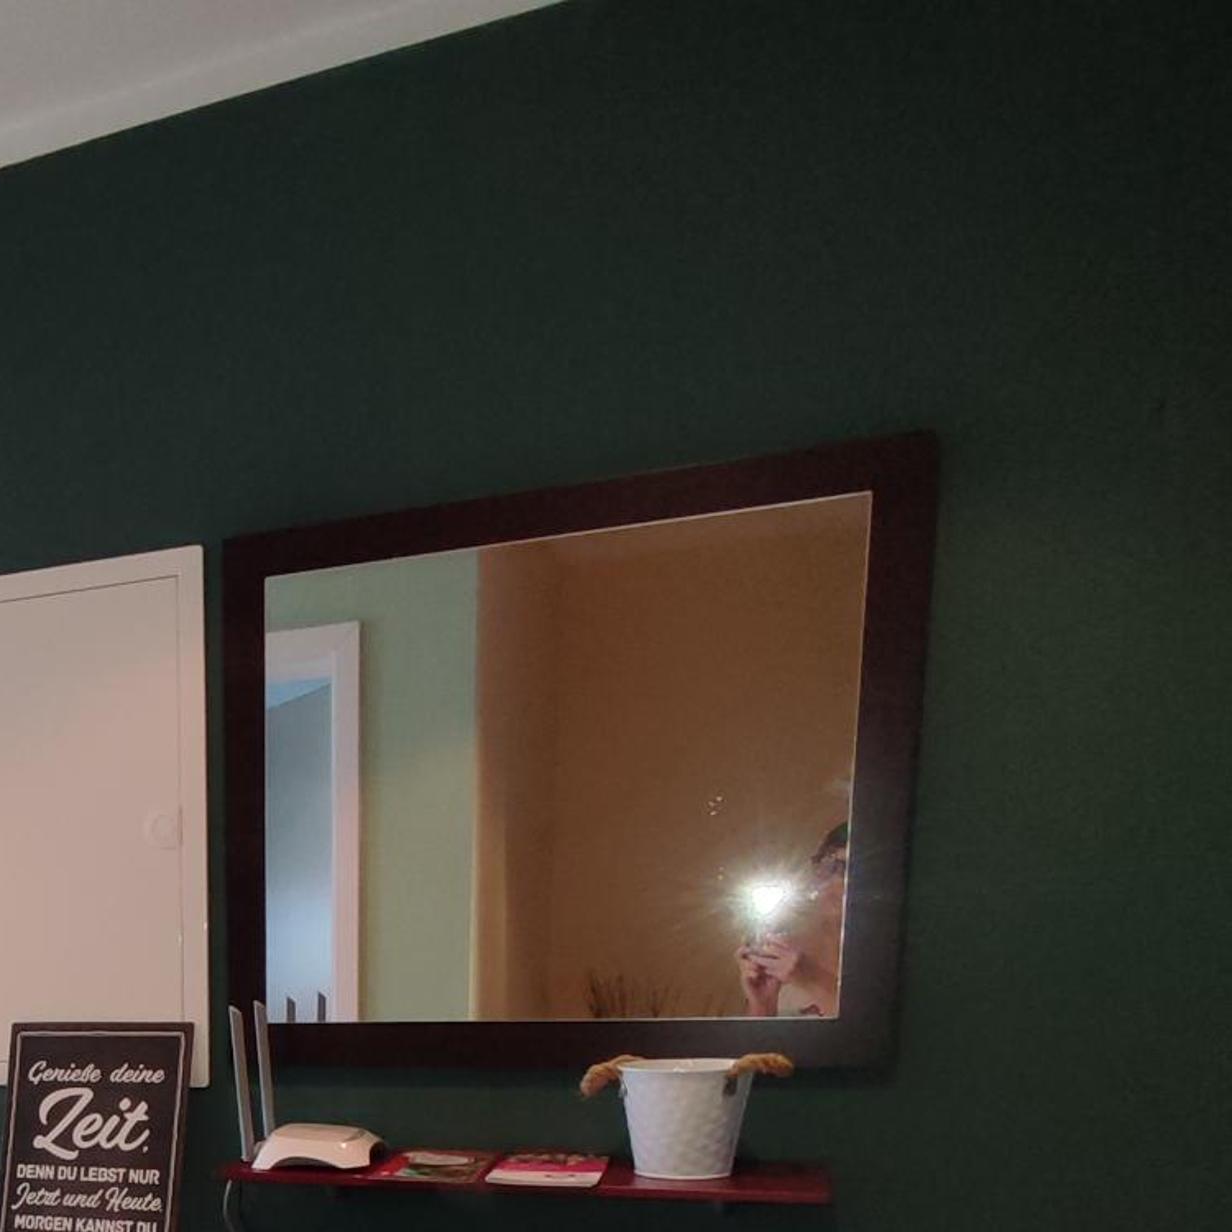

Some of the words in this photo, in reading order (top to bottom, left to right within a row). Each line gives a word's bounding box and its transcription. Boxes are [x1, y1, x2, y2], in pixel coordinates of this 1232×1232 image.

[28, 1060, 101, 1084] Genieße
[110, 1064, 165, 1084] deine
[33, 1086, 151, 1160] Zeit.
[17, 1164, 54, 1180] DENN
[58, 1166, 77, 1181] DU
[80, 1168, 127, 1183] LEBST
[128, 1169, 160, 1185] NUR
[12, 1183, 61, 1210] Jetzt
[63, 1188, 102, 1208] und
[14, 1215, 72, 1232] MORGEN
